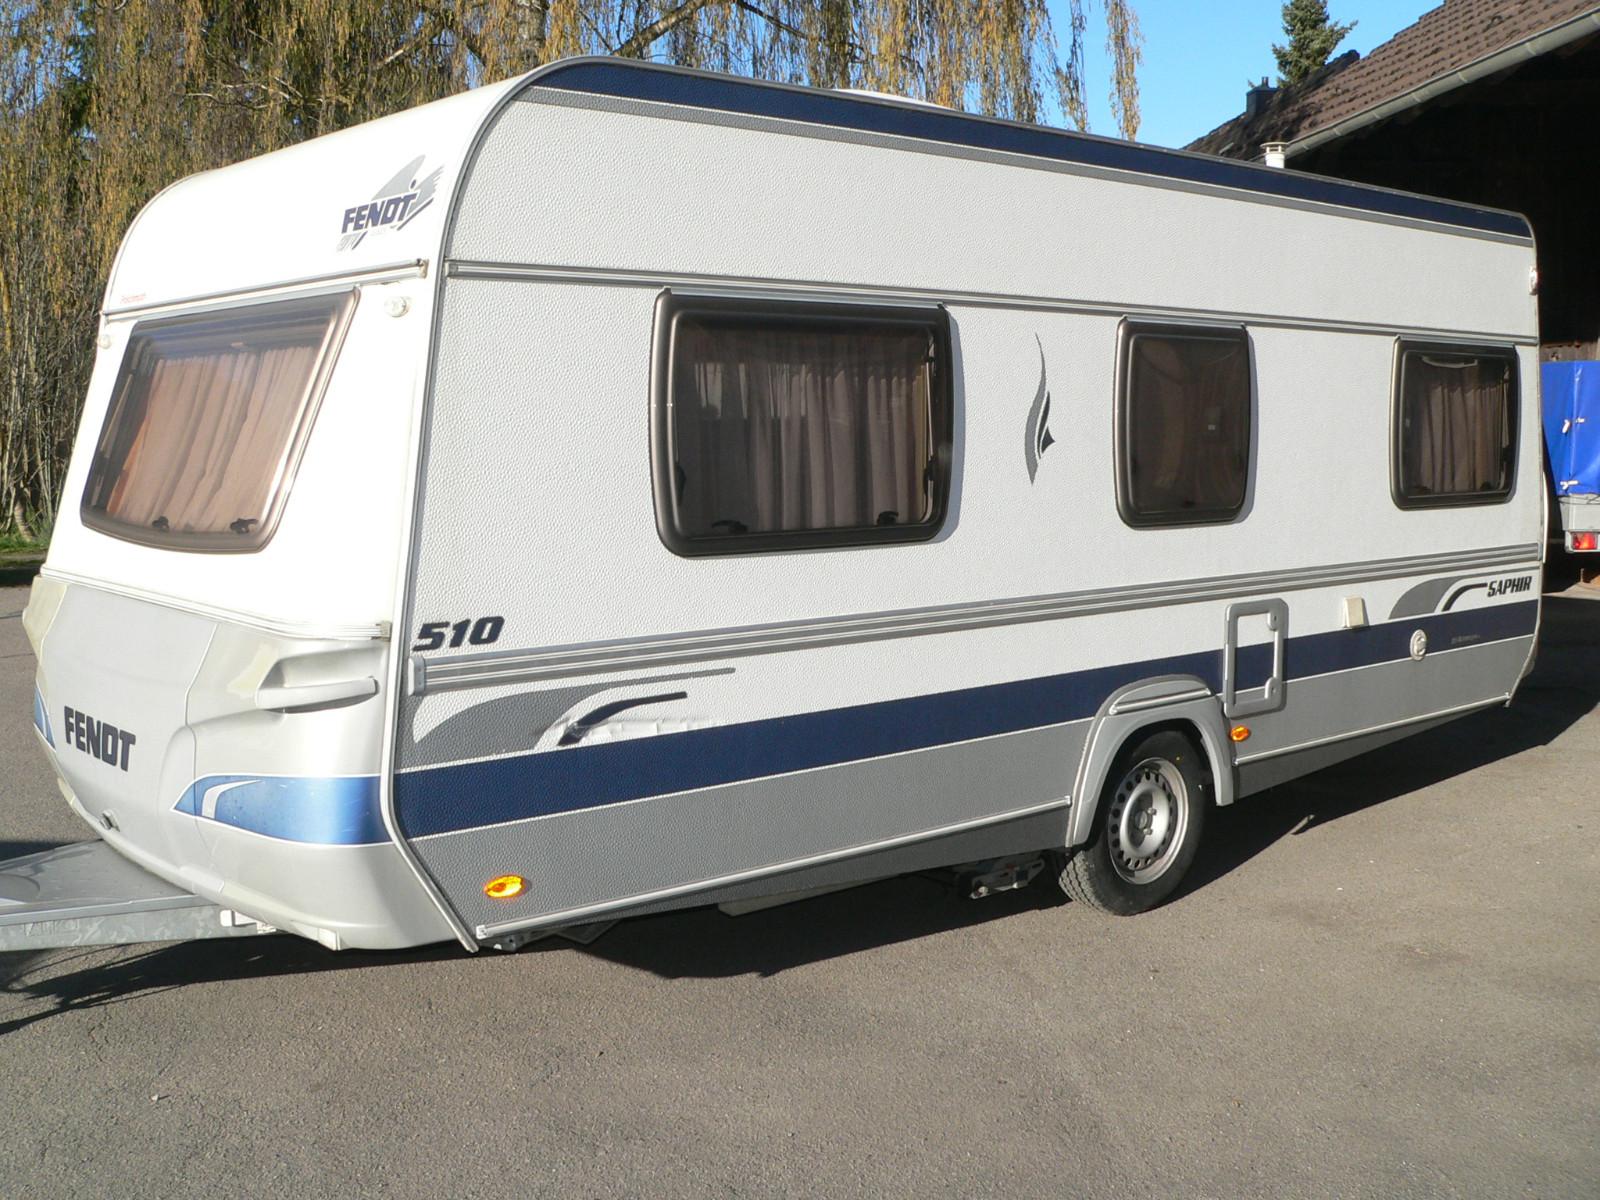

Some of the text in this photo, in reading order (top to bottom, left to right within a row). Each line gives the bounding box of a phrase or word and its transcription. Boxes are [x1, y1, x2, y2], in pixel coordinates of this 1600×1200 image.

[341, 193, 418, 234] FENDT
[1487, 576, 1532, 597] SAPHIR
[412, 616, 505, 652] 510
[64, 705, 136, 772] FENDT
